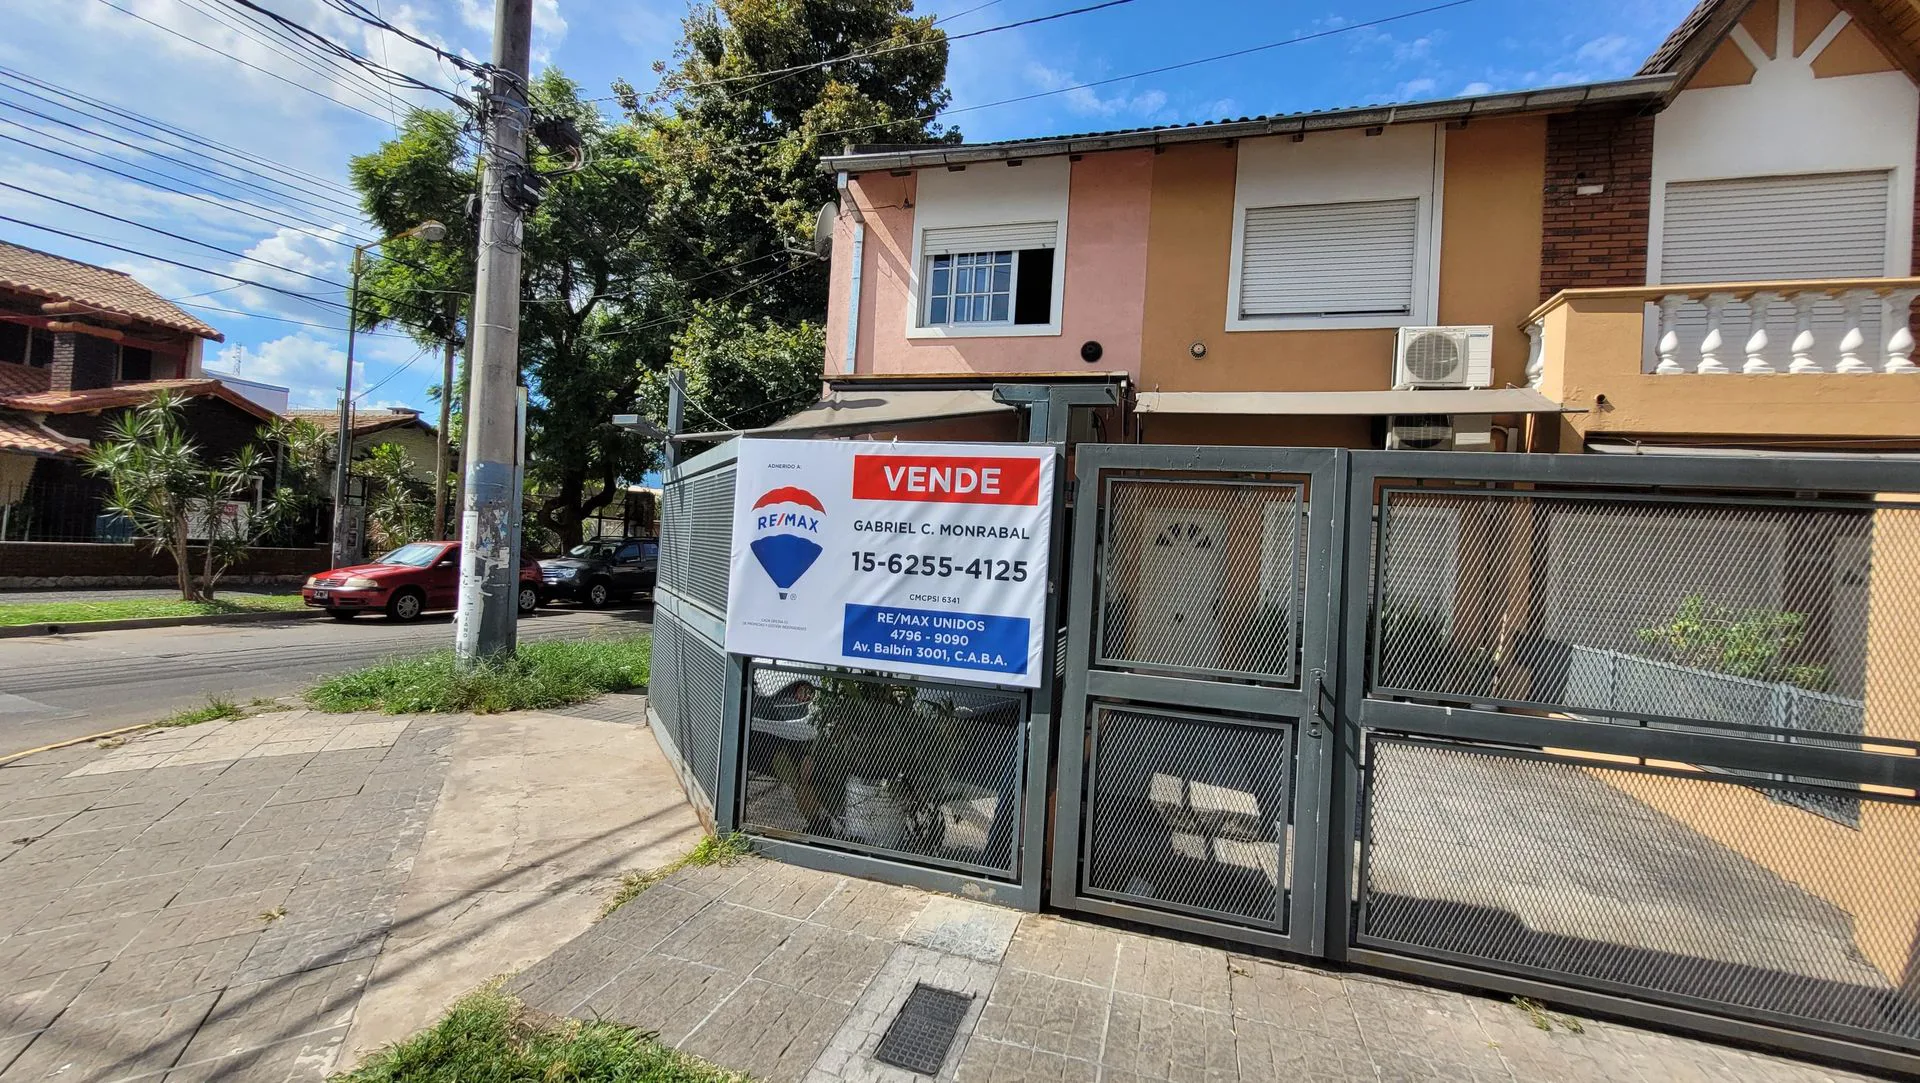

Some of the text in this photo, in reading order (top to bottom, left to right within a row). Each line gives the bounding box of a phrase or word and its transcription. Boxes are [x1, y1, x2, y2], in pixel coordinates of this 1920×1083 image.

[884, 466, 1001, 494] VENDE
[758, 513, 819, 533] RE/MAX
[854, 520, 1030, 539] GABRIEL C. MONRABAL
[852, 551, 1028, 582] 15-6255-4125
[909, 594, 960, 604] CMCPSI 6341
[877, 612, 985, 632] RE/MAX UNIDOS
[890, 629, 921, 641] 4796
[935, 633, 969, 646] 9090
[853, 641, 1007, 666] Av. Balbín 3001, C.A.B.A.
